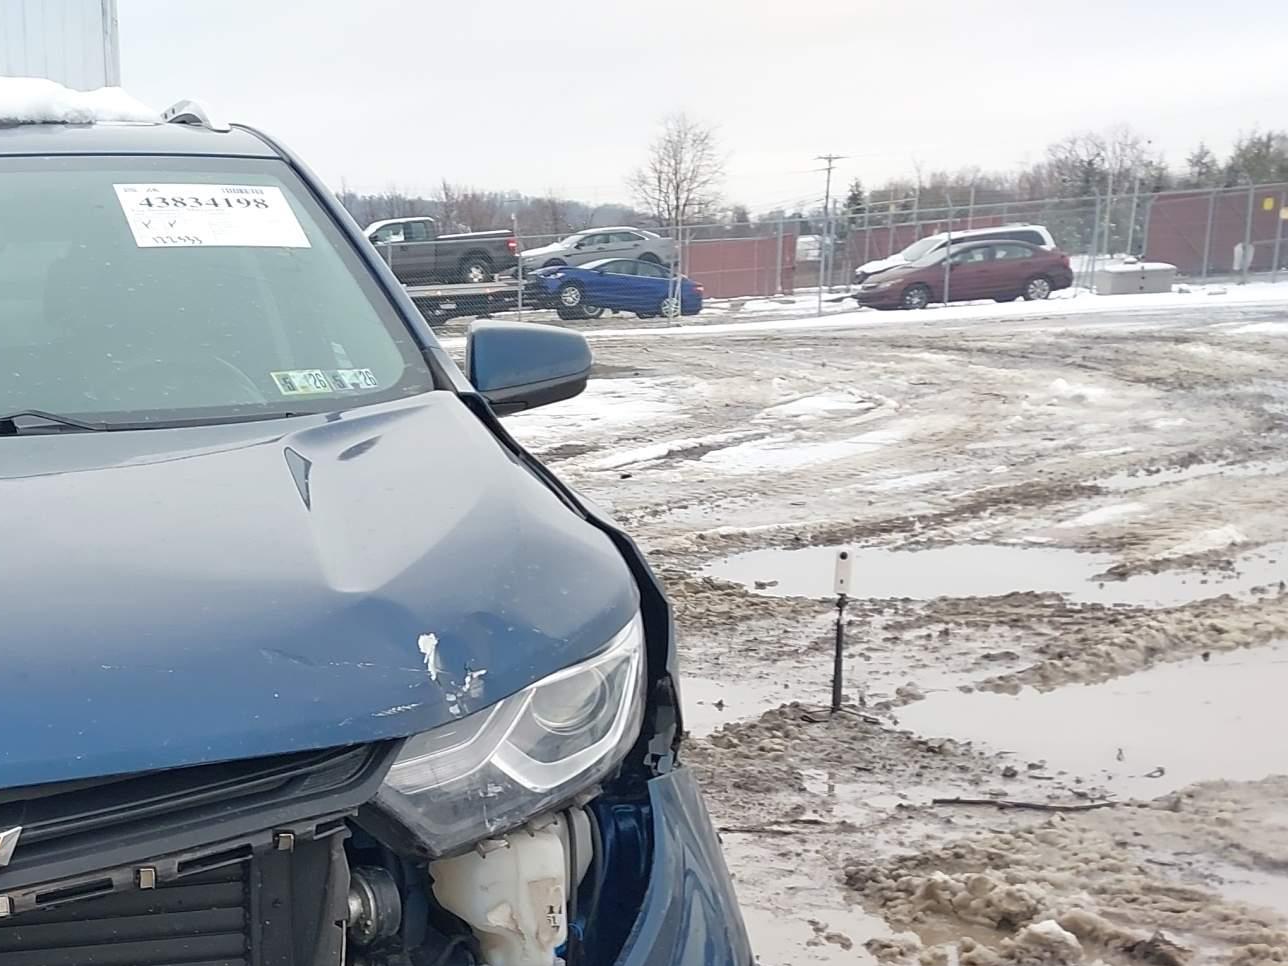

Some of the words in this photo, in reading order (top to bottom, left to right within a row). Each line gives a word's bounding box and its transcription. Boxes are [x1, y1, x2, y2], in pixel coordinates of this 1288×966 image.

[138, 196, 270, 209] 43834198
[312, 372, 328, 390] 26
[362, 370, 378, 387] 26
